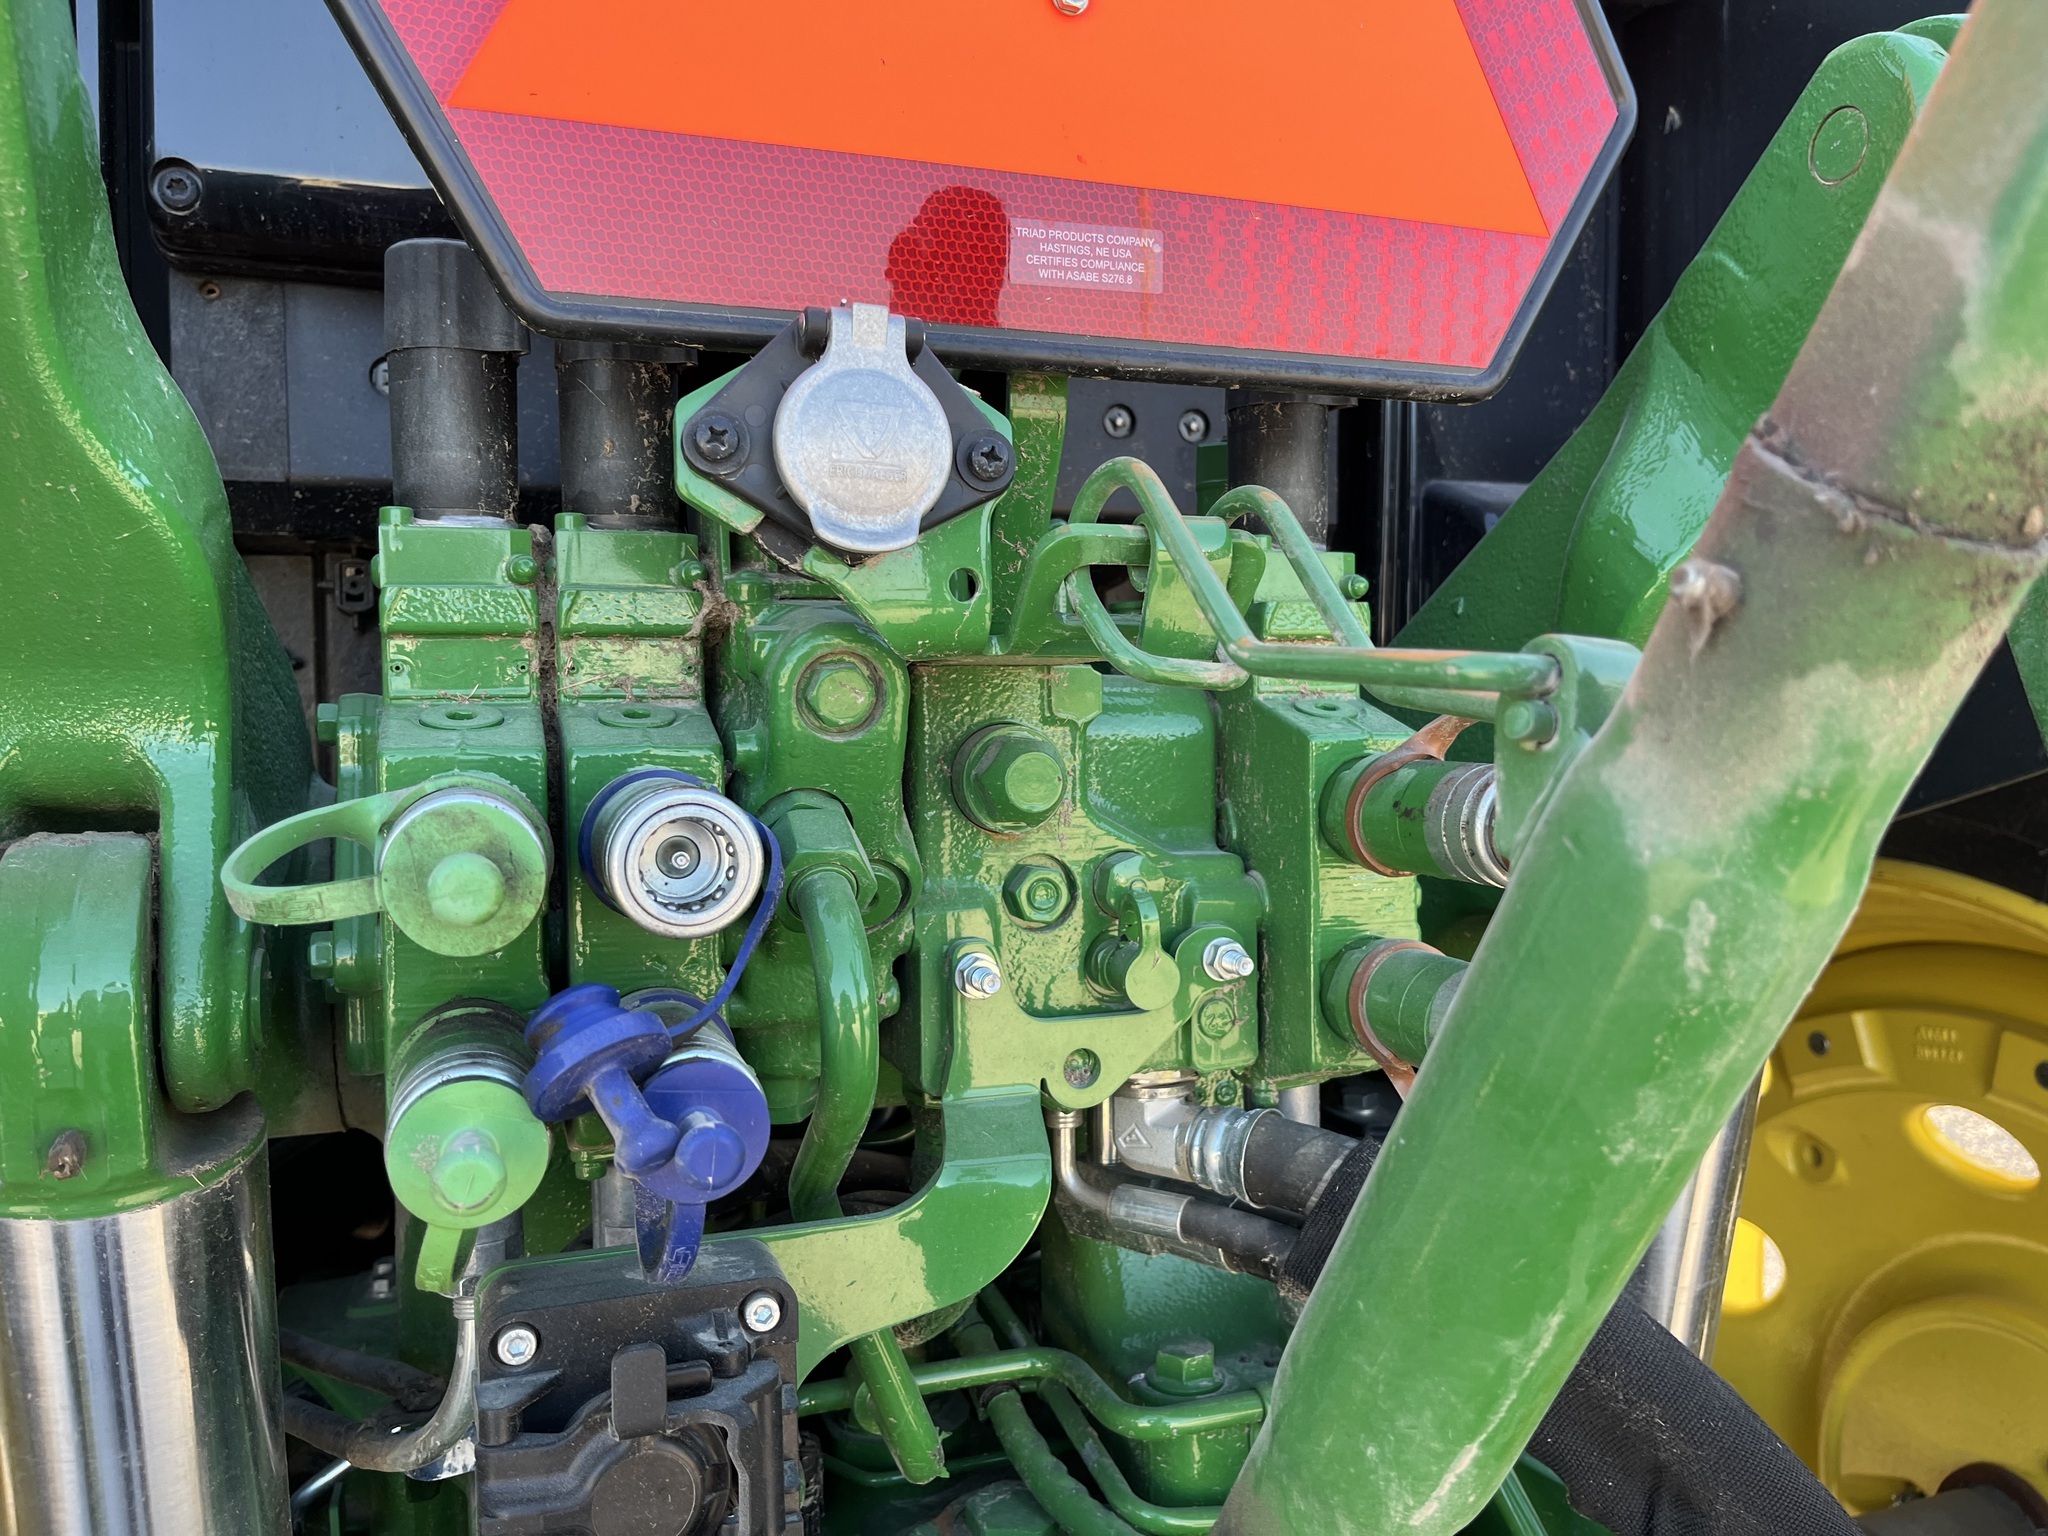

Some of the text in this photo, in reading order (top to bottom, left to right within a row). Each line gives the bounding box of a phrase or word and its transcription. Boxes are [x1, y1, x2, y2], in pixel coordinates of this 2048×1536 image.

[1015, 227, 1155, 248] TRIAD PRODUCTS COMPANY
[1039, 242, 1132, 259] HASTINGS, NE USA
[1025, 254, 1145, 273] CERTIFIES COMPLIANCE
[1038, 268, 1133, 285] WITH ASABE S276.8
